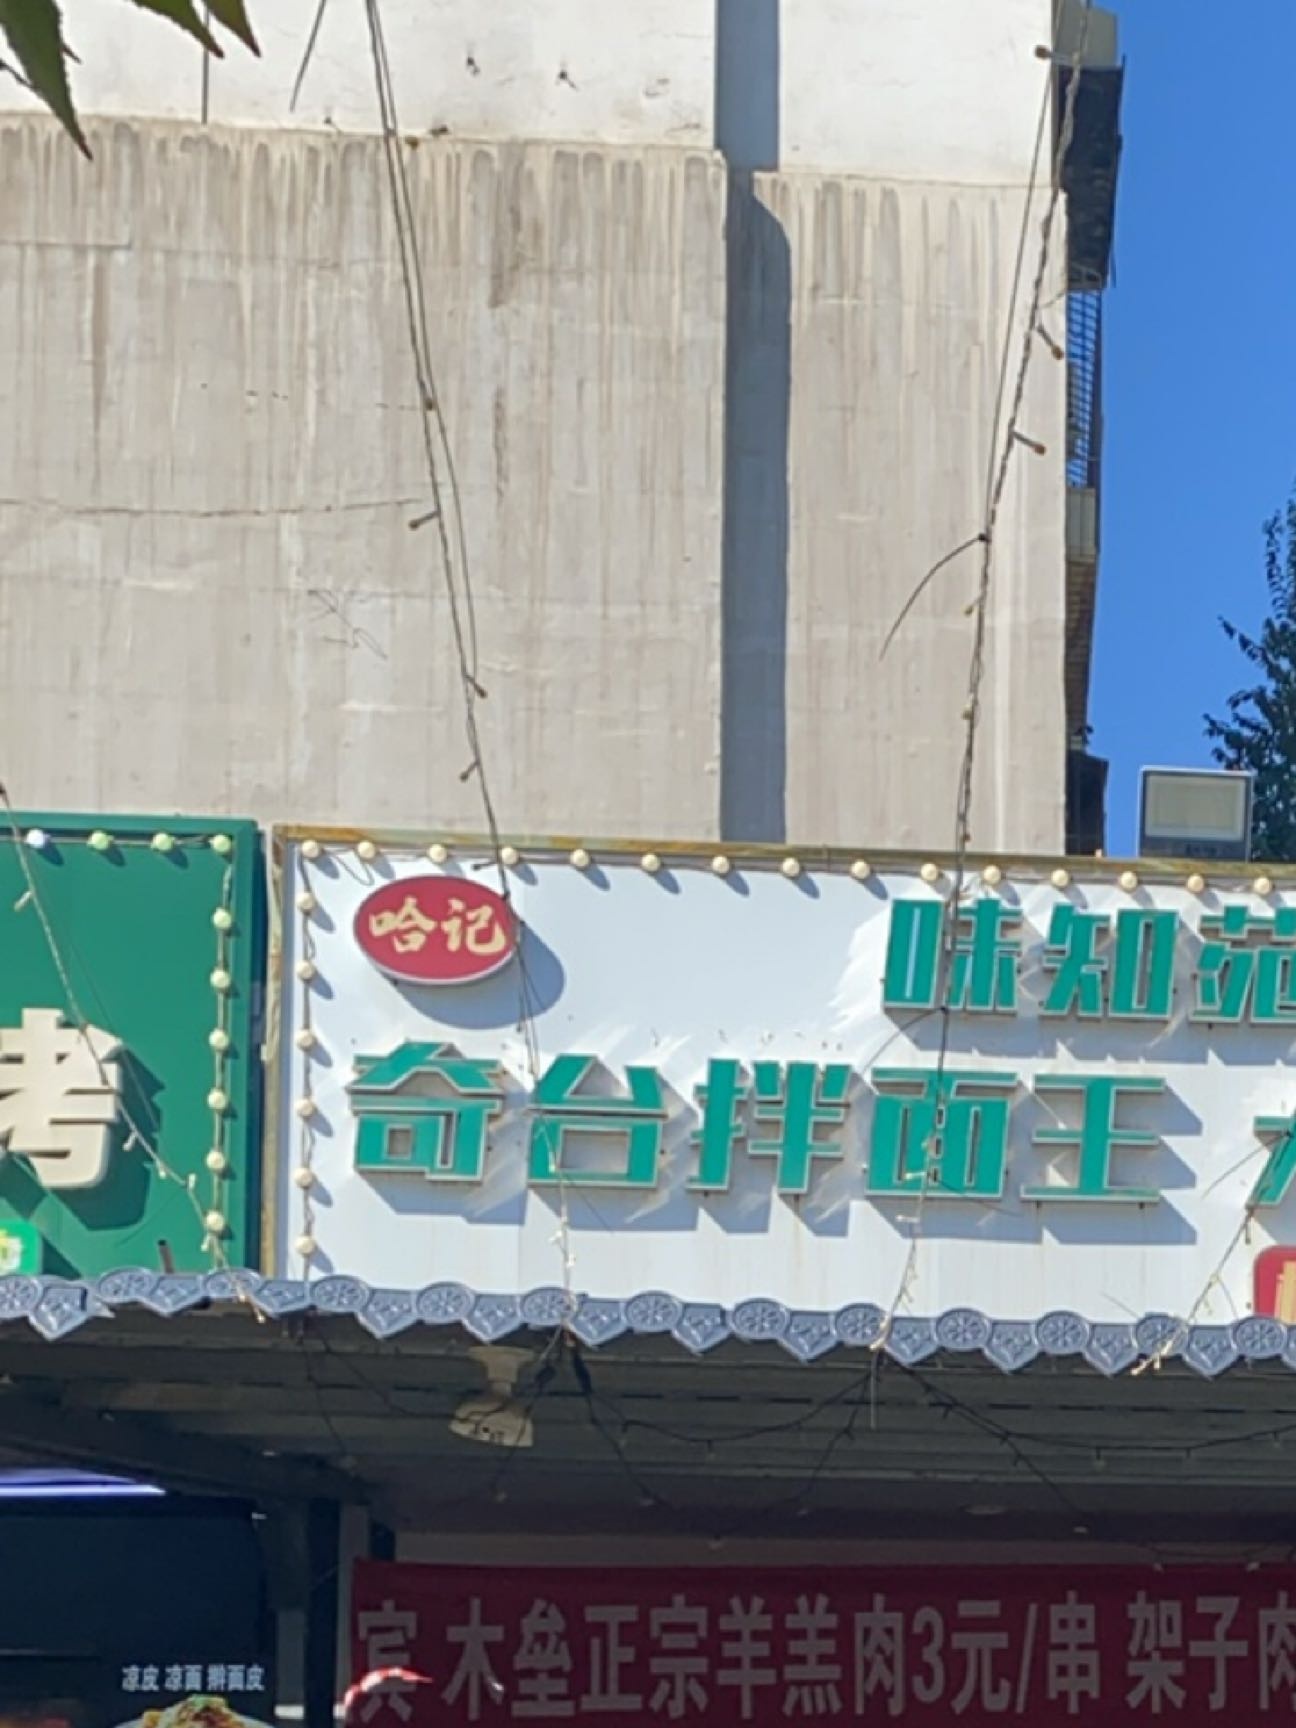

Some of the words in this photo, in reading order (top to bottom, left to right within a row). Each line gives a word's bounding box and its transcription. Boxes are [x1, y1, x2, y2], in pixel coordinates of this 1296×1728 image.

[369, 895, 506, 955] 哈记
[348, 1041, 1164, 1206] 奇台拌面王
[121, 1664, 160, 1691] 凉皮
[164, 1664, 203, 1691] 凉面
[441, 1591, 1102, 1722] 木垒正宗羊羔肉3元/串
